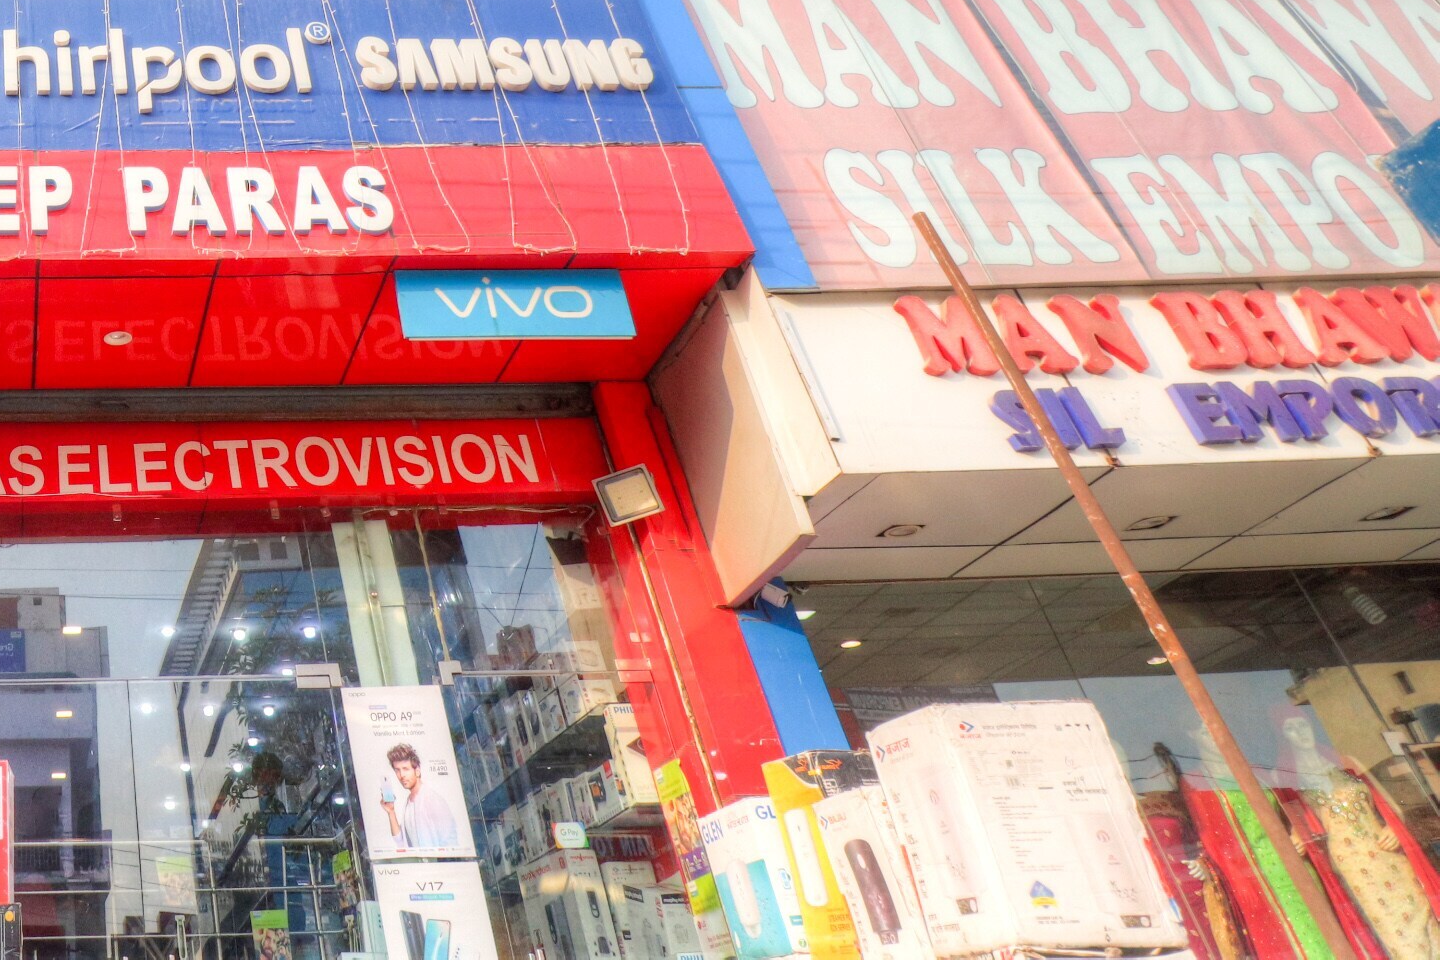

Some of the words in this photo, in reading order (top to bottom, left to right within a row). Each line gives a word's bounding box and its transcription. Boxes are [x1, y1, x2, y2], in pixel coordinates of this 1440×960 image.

[355, 34, 657, 94] SAMSUNG
[125, 163, 396, 238] PARAS
[823, 146, 1120, 268] SILK
[1090, 152, 1426, 276] EMPO
[433, 275, 595, 321] vivo
[894, 292, 1150, 377] MAN
[1149, 282, 1440, 372] BHAW
[59, 433, 541, 495] ELECTROVISION
[370, 712, 396, 722] OPPO
[400, 711, 413, 721] A9
[701, 819, 724, 844] GLEN
[416, 881, 444, 891] V17
